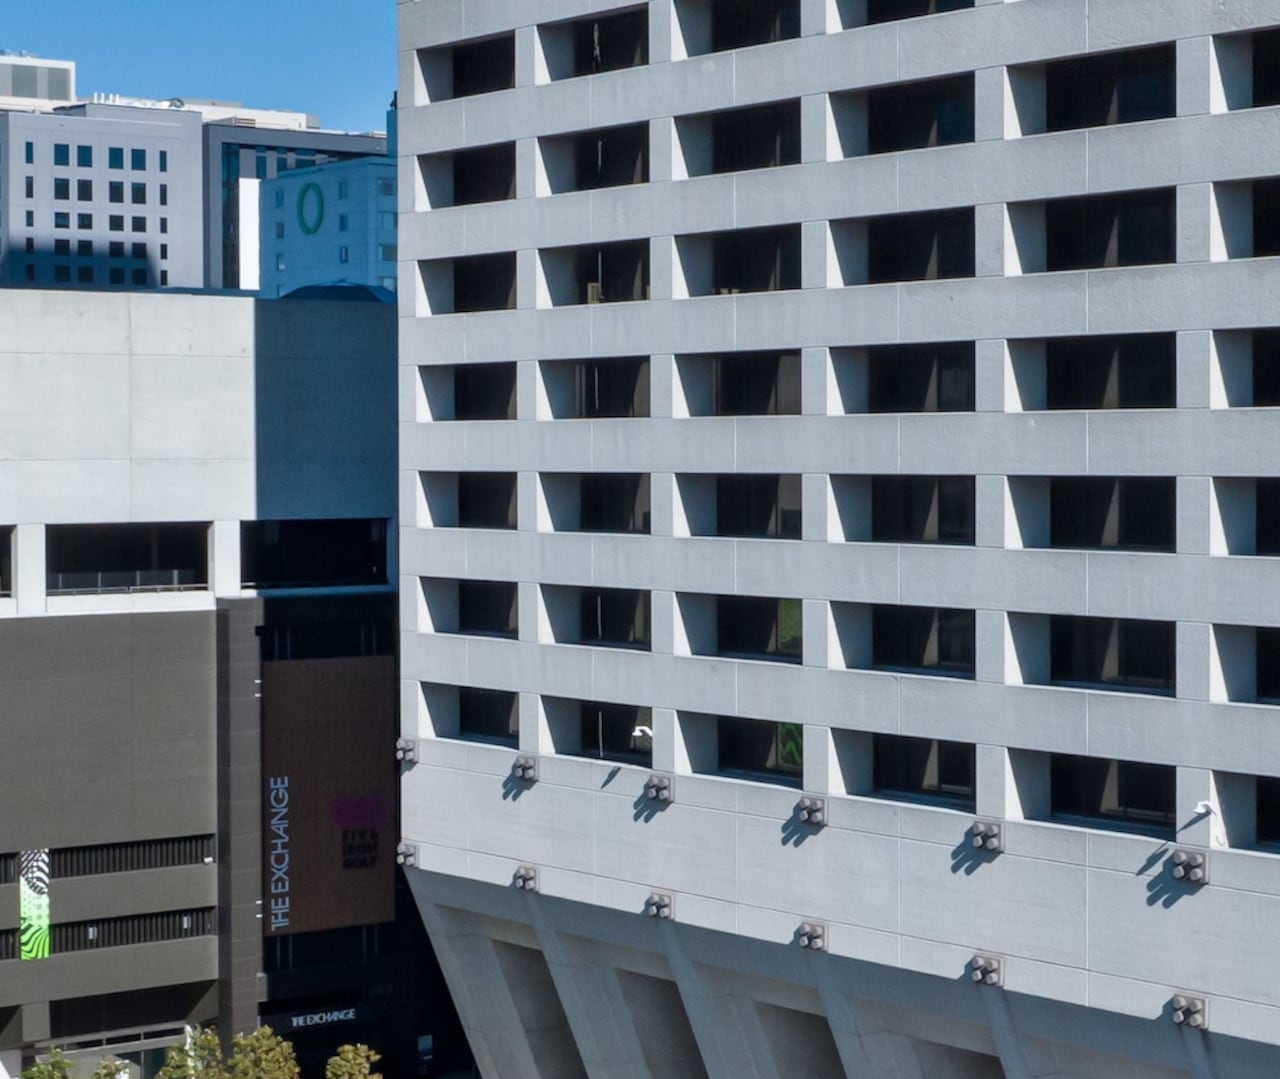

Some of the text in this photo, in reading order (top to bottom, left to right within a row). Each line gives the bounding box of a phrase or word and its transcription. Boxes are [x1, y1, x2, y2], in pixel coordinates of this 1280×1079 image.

[270, 776, 290, 931] THE EXCHANGE
[291, 1008, 356, 1027] THE EXCHANGE
